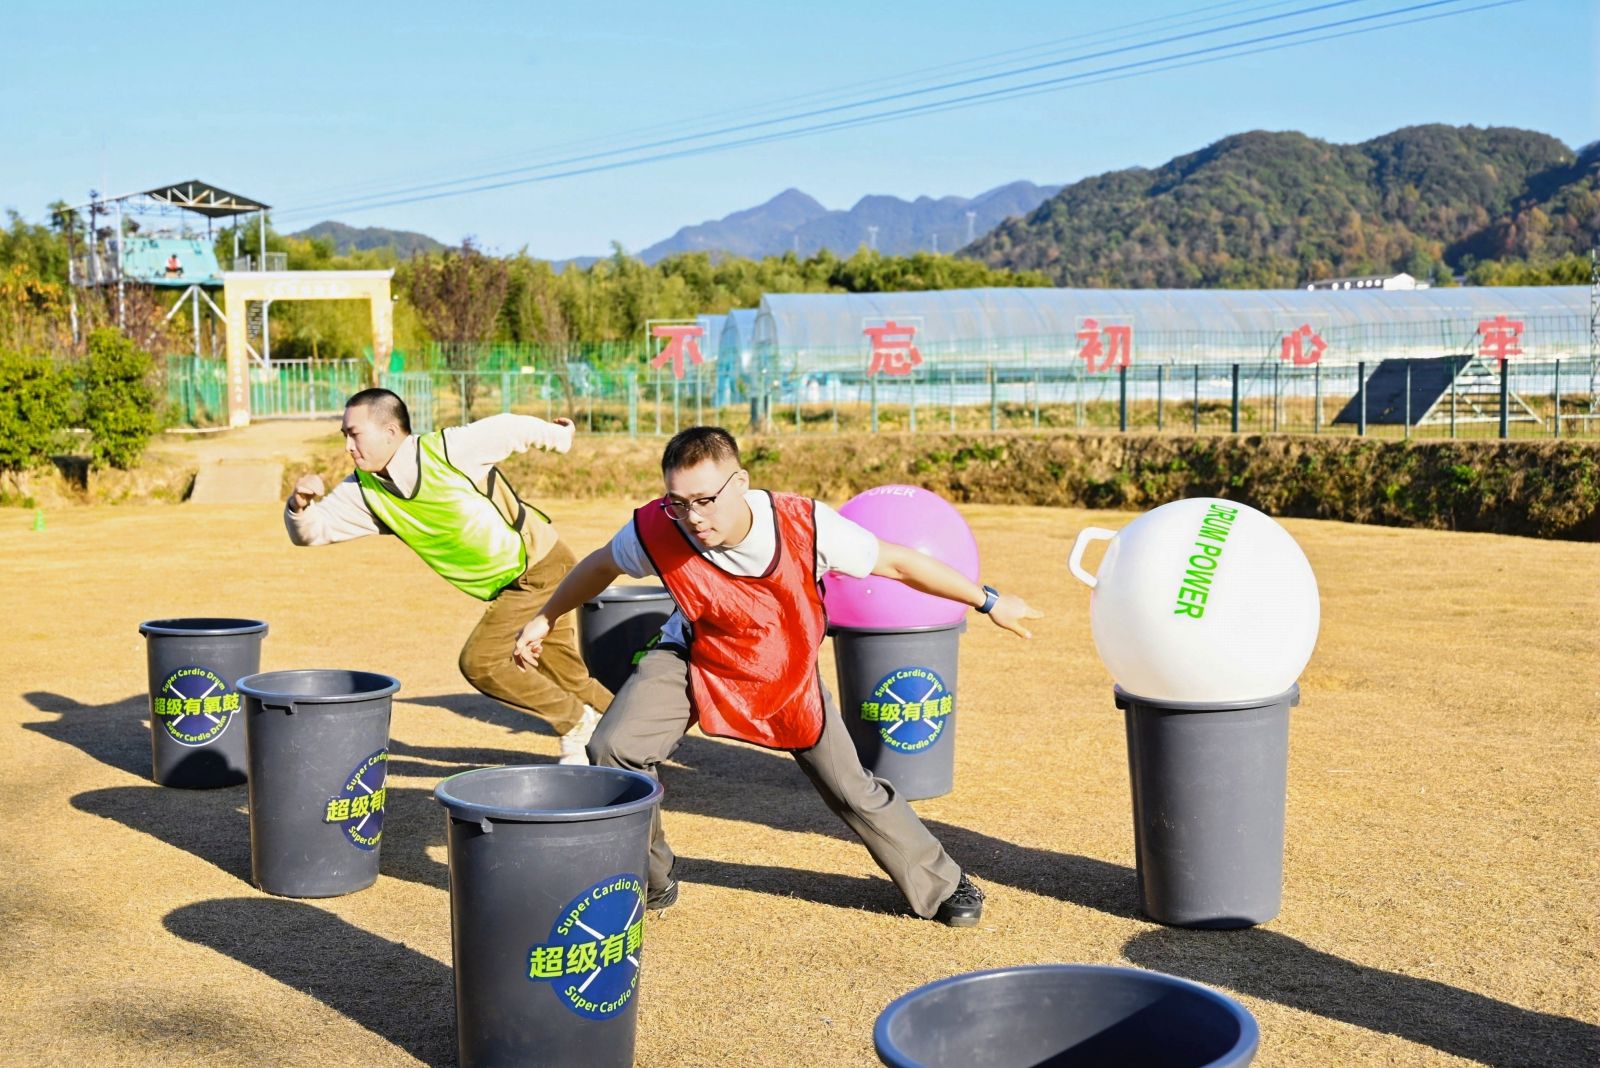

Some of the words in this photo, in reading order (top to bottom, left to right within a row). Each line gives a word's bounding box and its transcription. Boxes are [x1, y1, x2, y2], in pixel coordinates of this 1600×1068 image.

[1198, 504, 1238, 542] DRUM
[1174, 542, 1222, 619] POWER
[162, 673, 178, 693] Super
[177, 668, 206, 677] Cardio
[207, 672, 225, 691] Drum
[875, 675, 896, 698] Super
[896, 669, 926, 680] Cardio
[927, 673, 943, 692] Drum
[154, 692, 239, 716] 超级有氧鼓
[861, 694, 952, 721] 超级有氧鼓
[166, 720, 183, 739] Super
[184, 733, 211, 742] Cardio
[210, 715, 227, 735] Drum
[880, 728, 901, 748] Super
[901, 739, 929, 750] Cardio
[928, 720, 943, 742] Drum
[346, 764, 368, 792] Super
[326, 787, 386, 822] 超级有
[349, 826, 368, 845] Super
[557, 896, 591, 936] Super
[592, 878, 631, 900] Cardio
[529, 914, 647, 979] 超级有氧
[564, 985, 599, 1013] Super
[600, 989, 631, 1014] Cardio
